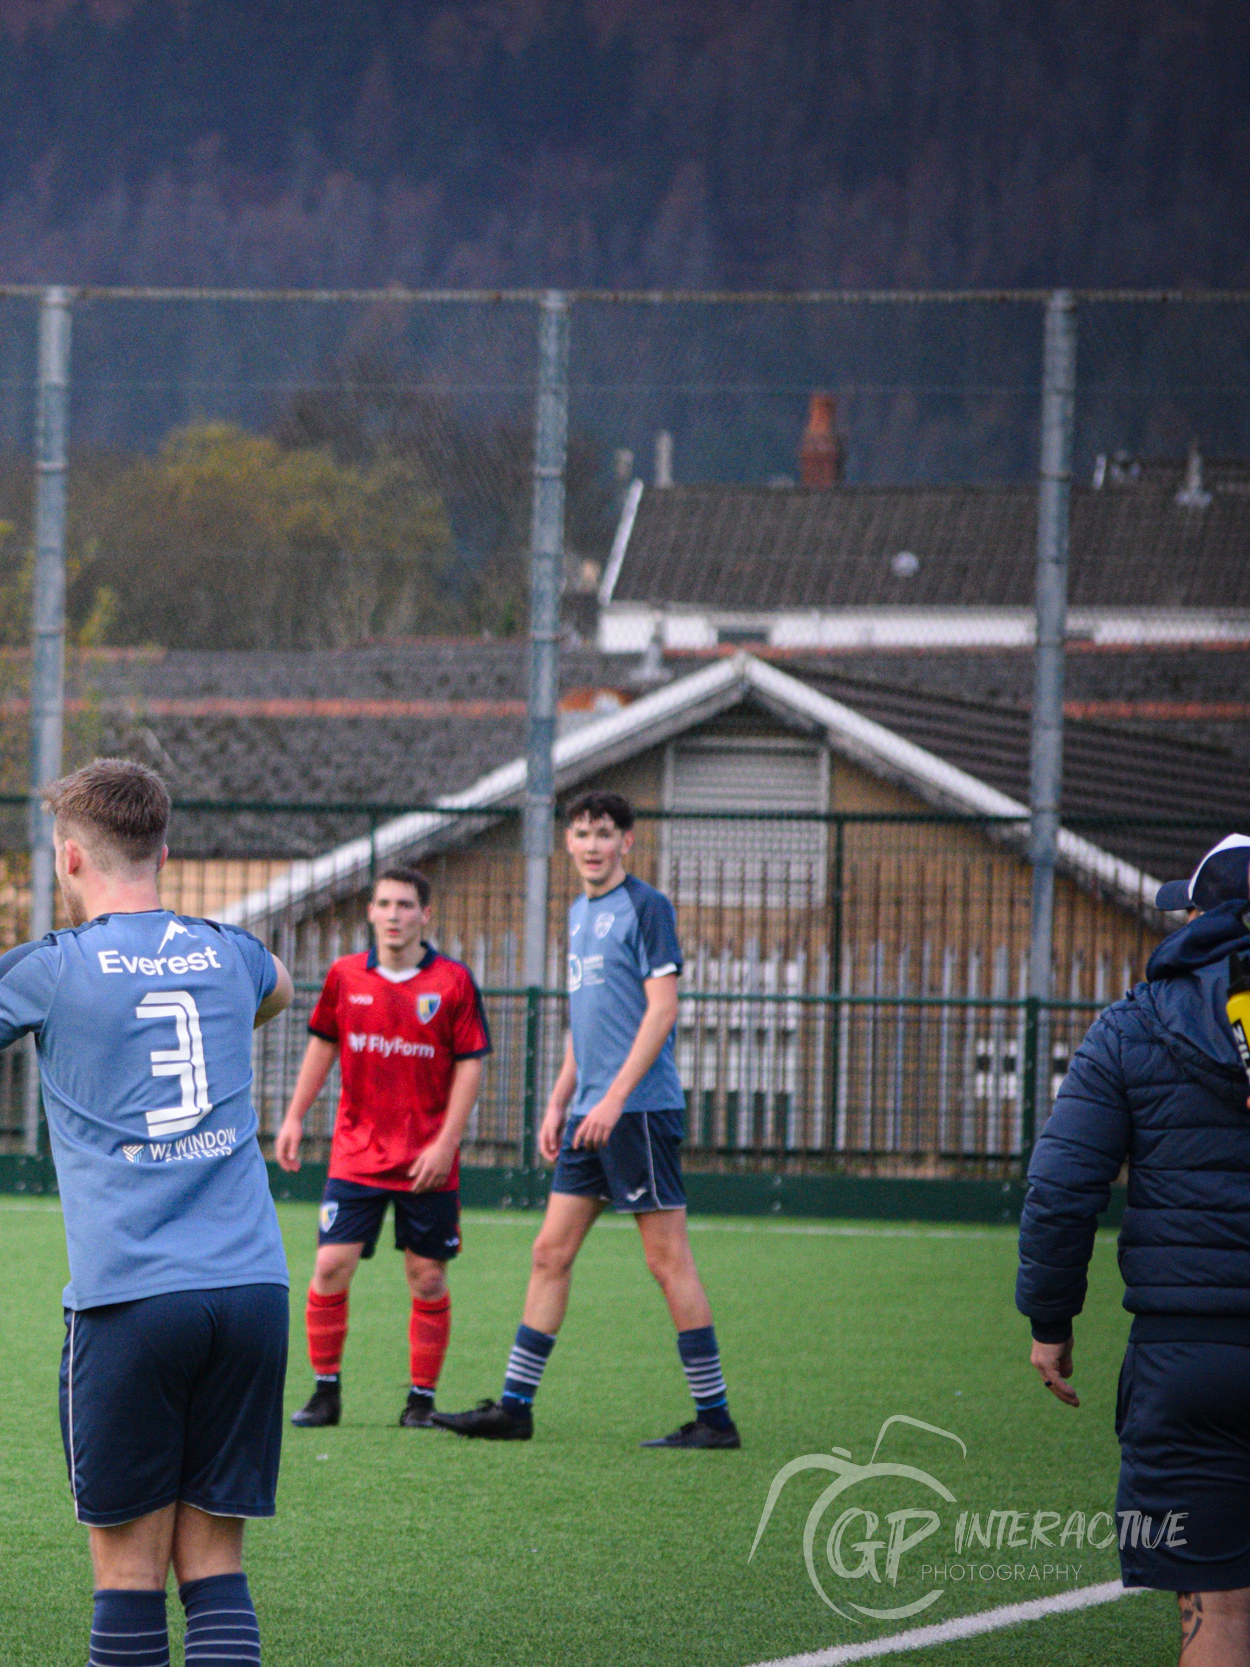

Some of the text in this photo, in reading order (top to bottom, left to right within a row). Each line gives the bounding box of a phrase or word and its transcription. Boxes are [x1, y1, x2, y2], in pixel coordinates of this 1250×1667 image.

[98, 946, 221, 976] Everest
[367, 1034, 435, 1059] FlyForm
[135, 990, 213, 1137] 3
[175, 1127, 237, 1155] WINDOW
